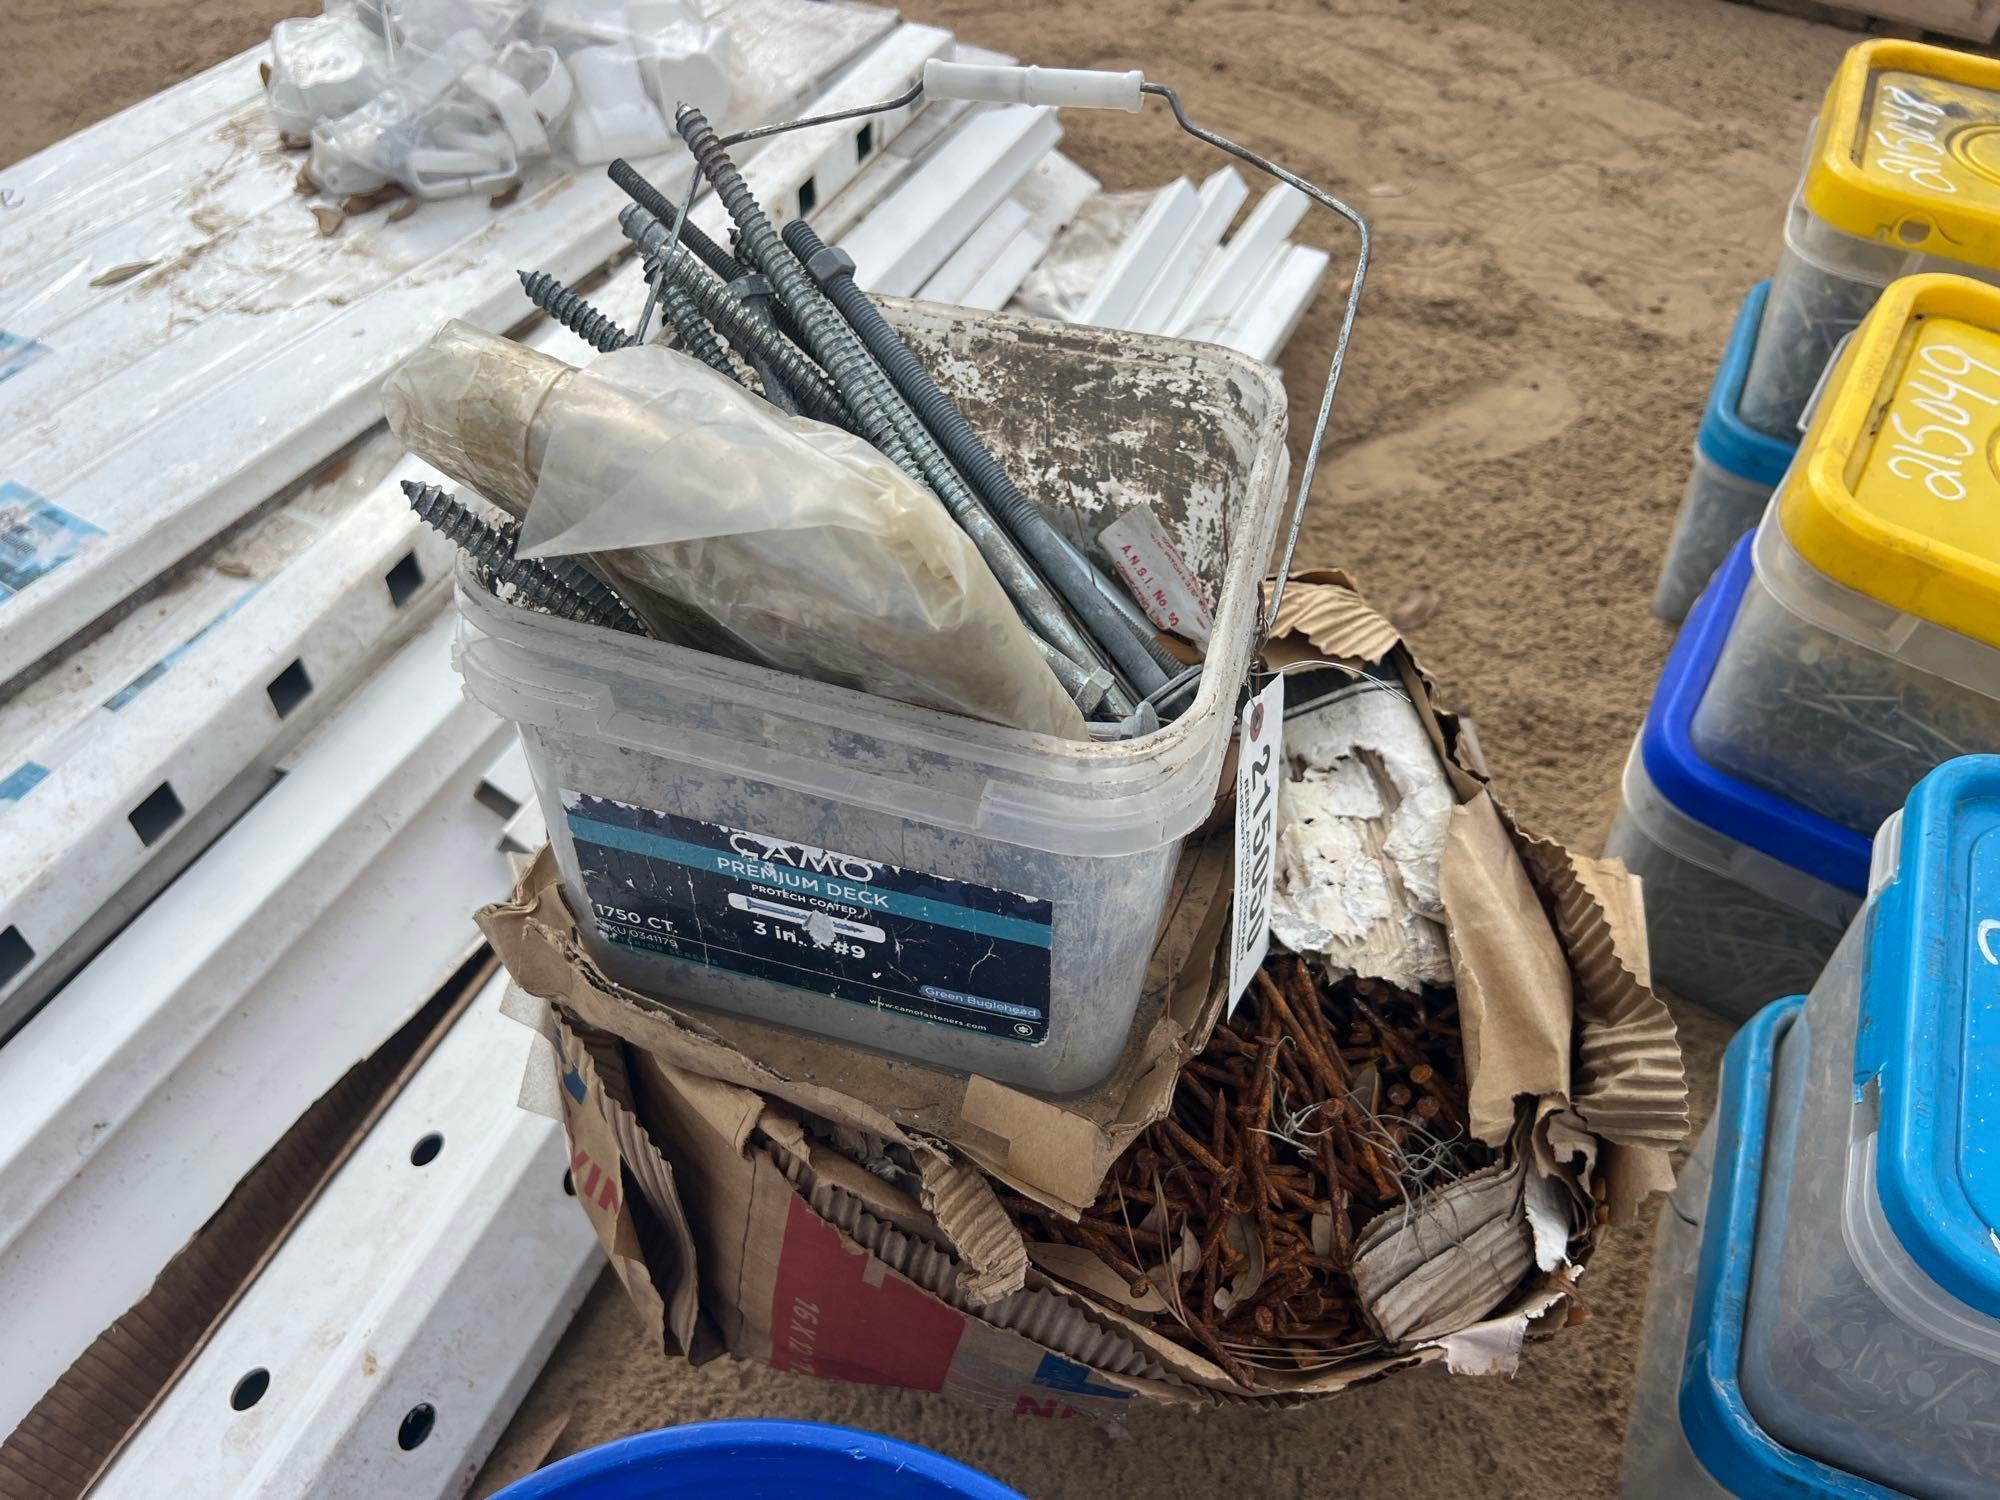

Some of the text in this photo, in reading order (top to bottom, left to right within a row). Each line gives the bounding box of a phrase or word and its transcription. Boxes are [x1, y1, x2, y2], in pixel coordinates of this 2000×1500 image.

[1874, 85, 1957, 192] 215048
[1888, 344, 2000, 501] 215049
[1121, 544, 1179, 627] A.N.S.I. No. 50
[729, 833, 874, 882] CAMO
[1246, 743, 1271, 953] 215050
[717, 856, 889, 908] PREMIUM DECK
[751, 883, 858, 915] PROTECH COATED
[596, 904, 679, 934] 1750 CT.
[752, 920, 767, 936] 3
[833, 940, 866, 959] #9
[869, 998, 987, 1032] www.camofasteners.com
[925, 986, 1037, 1018] Green Buglehead
[792, 1296, 820, 1326] 16
